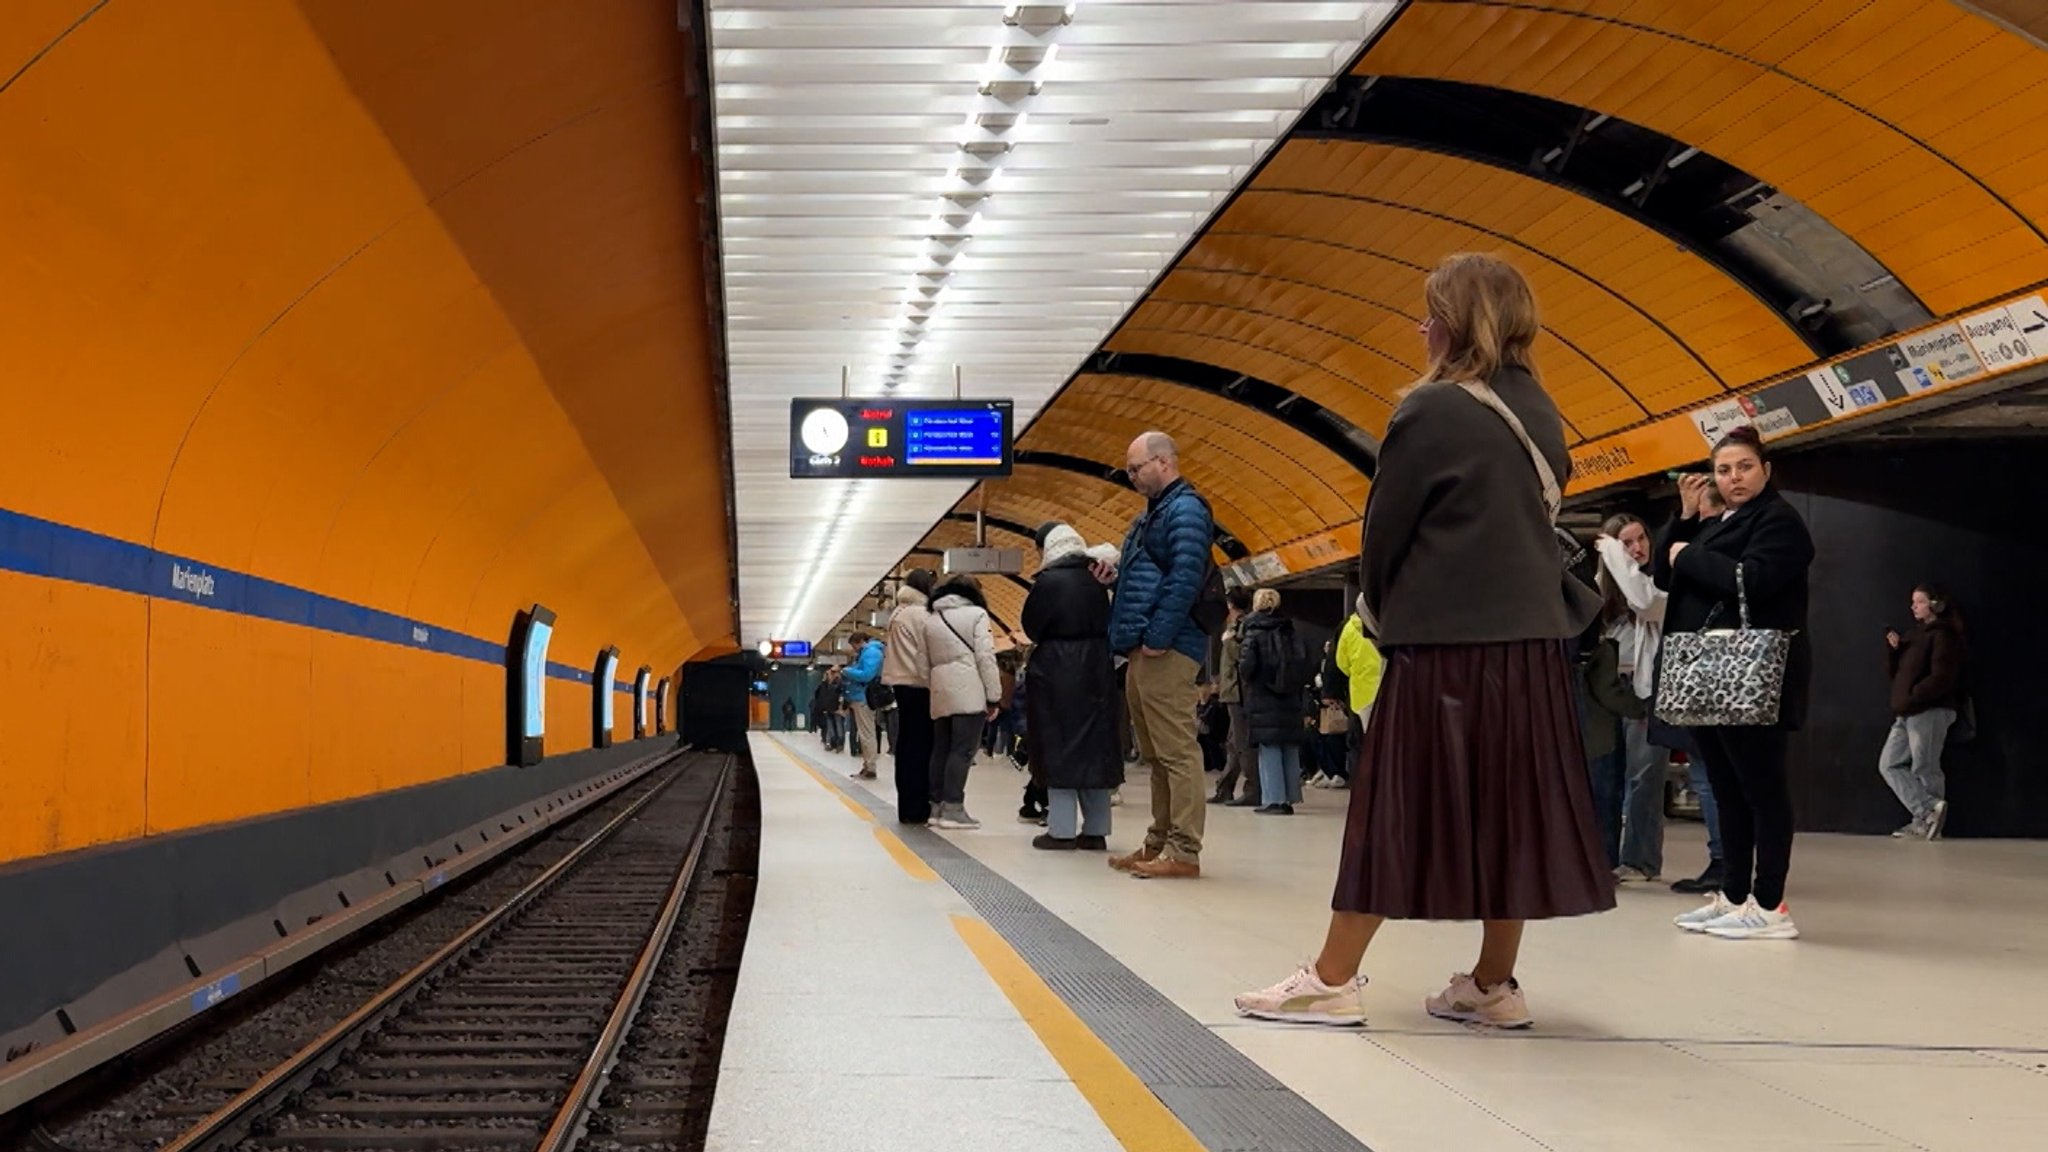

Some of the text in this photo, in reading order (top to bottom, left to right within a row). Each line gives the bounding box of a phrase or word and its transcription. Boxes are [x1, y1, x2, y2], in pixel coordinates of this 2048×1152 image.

[1965, 316, 2015, 338] Ausgang
[1906, 333, 1965, 358] Marienplatz
[1570, 446, 1634, 479] rienplatz
[172, 562, 215, 600] Marienplatz
